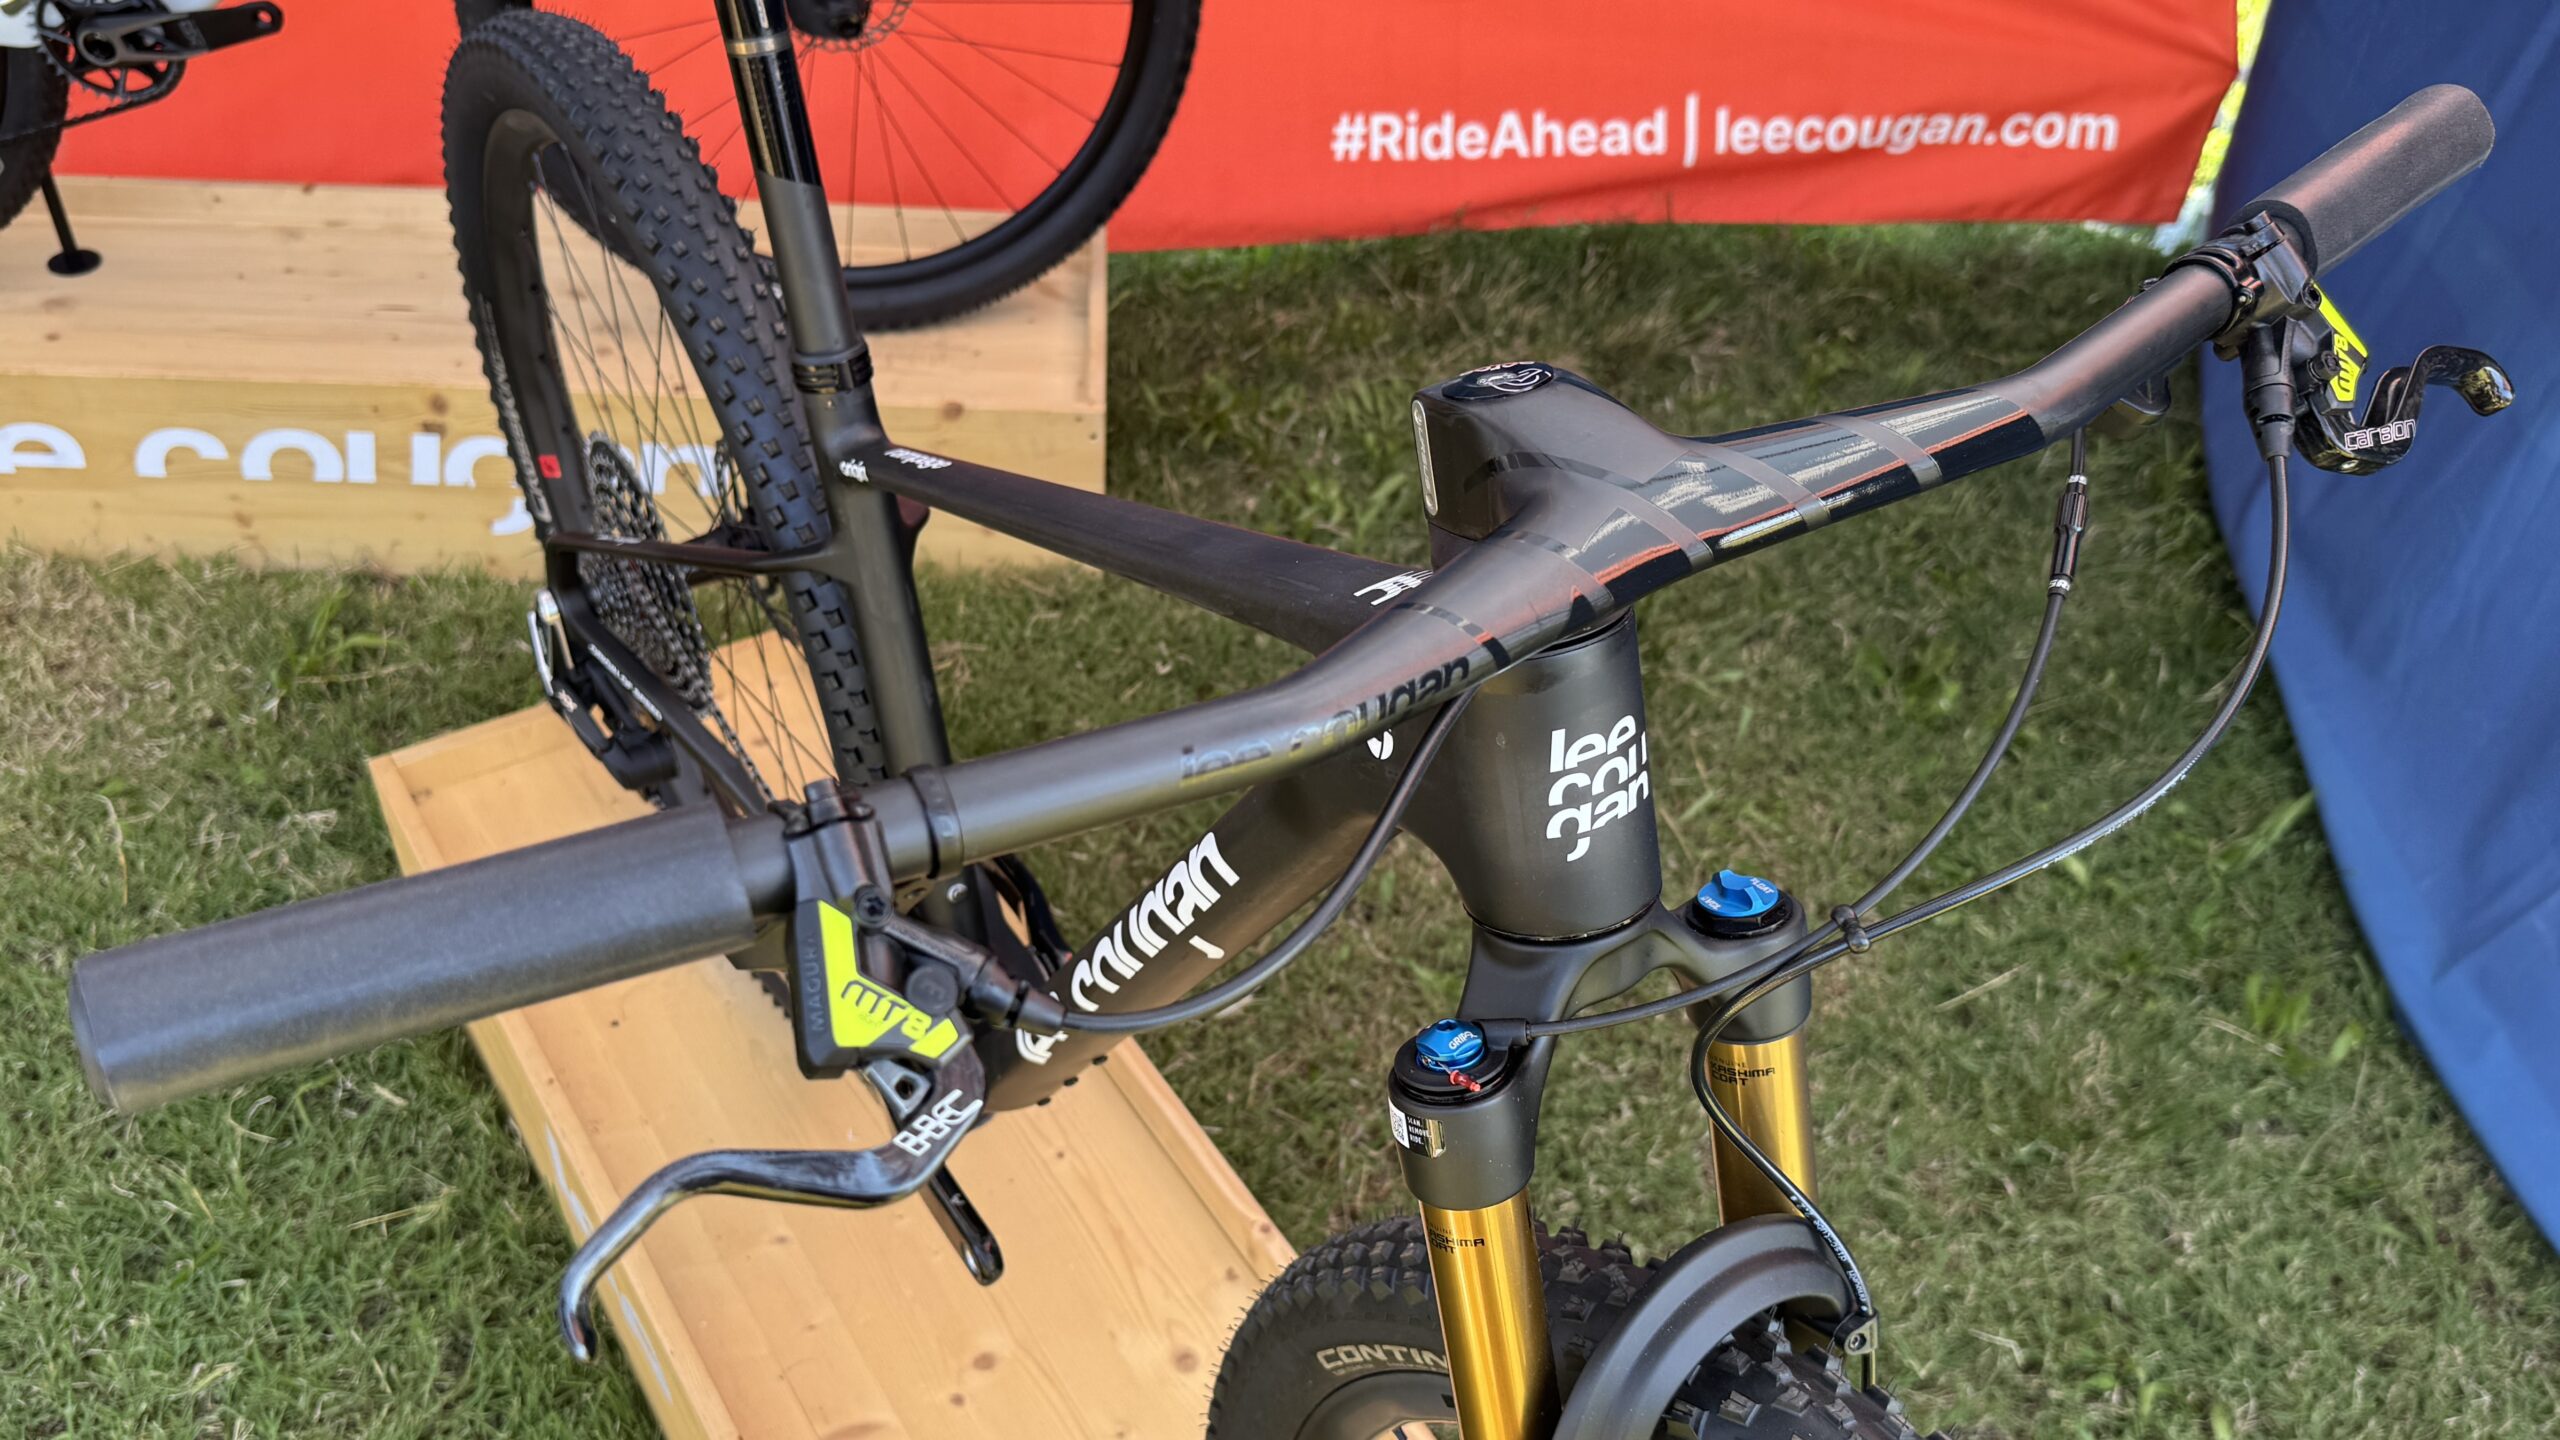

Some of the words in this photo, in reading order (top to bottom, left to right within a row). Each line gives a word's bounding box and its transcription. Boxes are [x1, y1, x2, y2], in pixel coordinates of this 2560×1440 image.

[1331, 110, 1668, 162] #RideAhead
[1714, 110, 2119, 156] leecougan.com
[1550, 714, 1637, 773] lee
[1546, 770, 1649, 862] gan
[1429, 1229, 1485, 1247] ASHIMA
[1431, 1238, 1456, 1254] OAT
[1316, 1343, 1448, 1370] CONTIN
